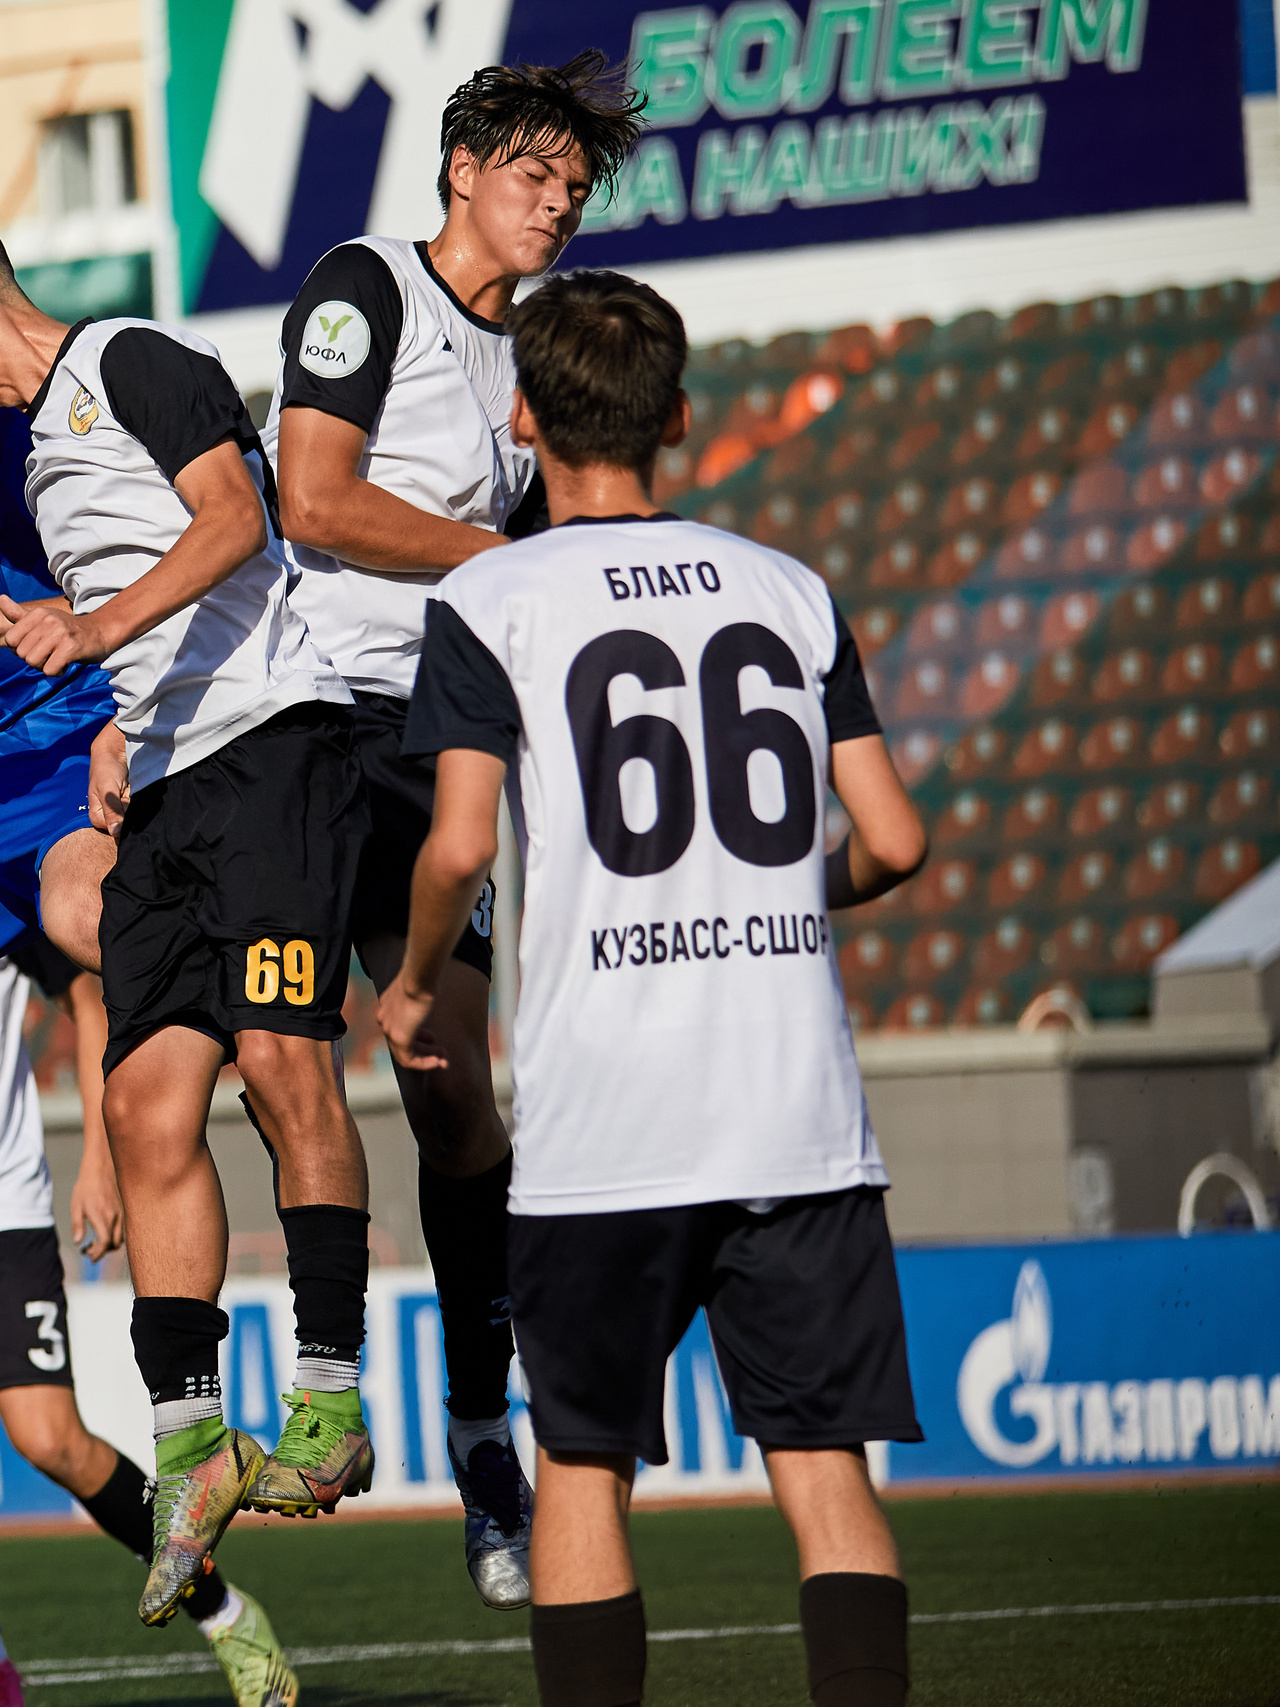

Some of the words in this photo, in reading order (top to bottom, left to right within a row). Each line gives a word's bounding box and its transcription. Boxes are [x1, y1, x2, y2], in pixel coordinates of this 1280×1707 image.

[628, 0, 1148, 131] БОЛЕЕМ
[576, 135, 687, 235] А
[692, 93, 1046, 220] НАШИХ!
[305, 344, 346, 364] ЮФЛ
[602, 561, 722, 601] БЛАГО
[565, 622, 816, 878] 66
[245, 938, 314, 1005] 69
[25, 1300, 66, 1371] 3
[1057, 1374, 1280, 1466] ГАЗПРОМ
